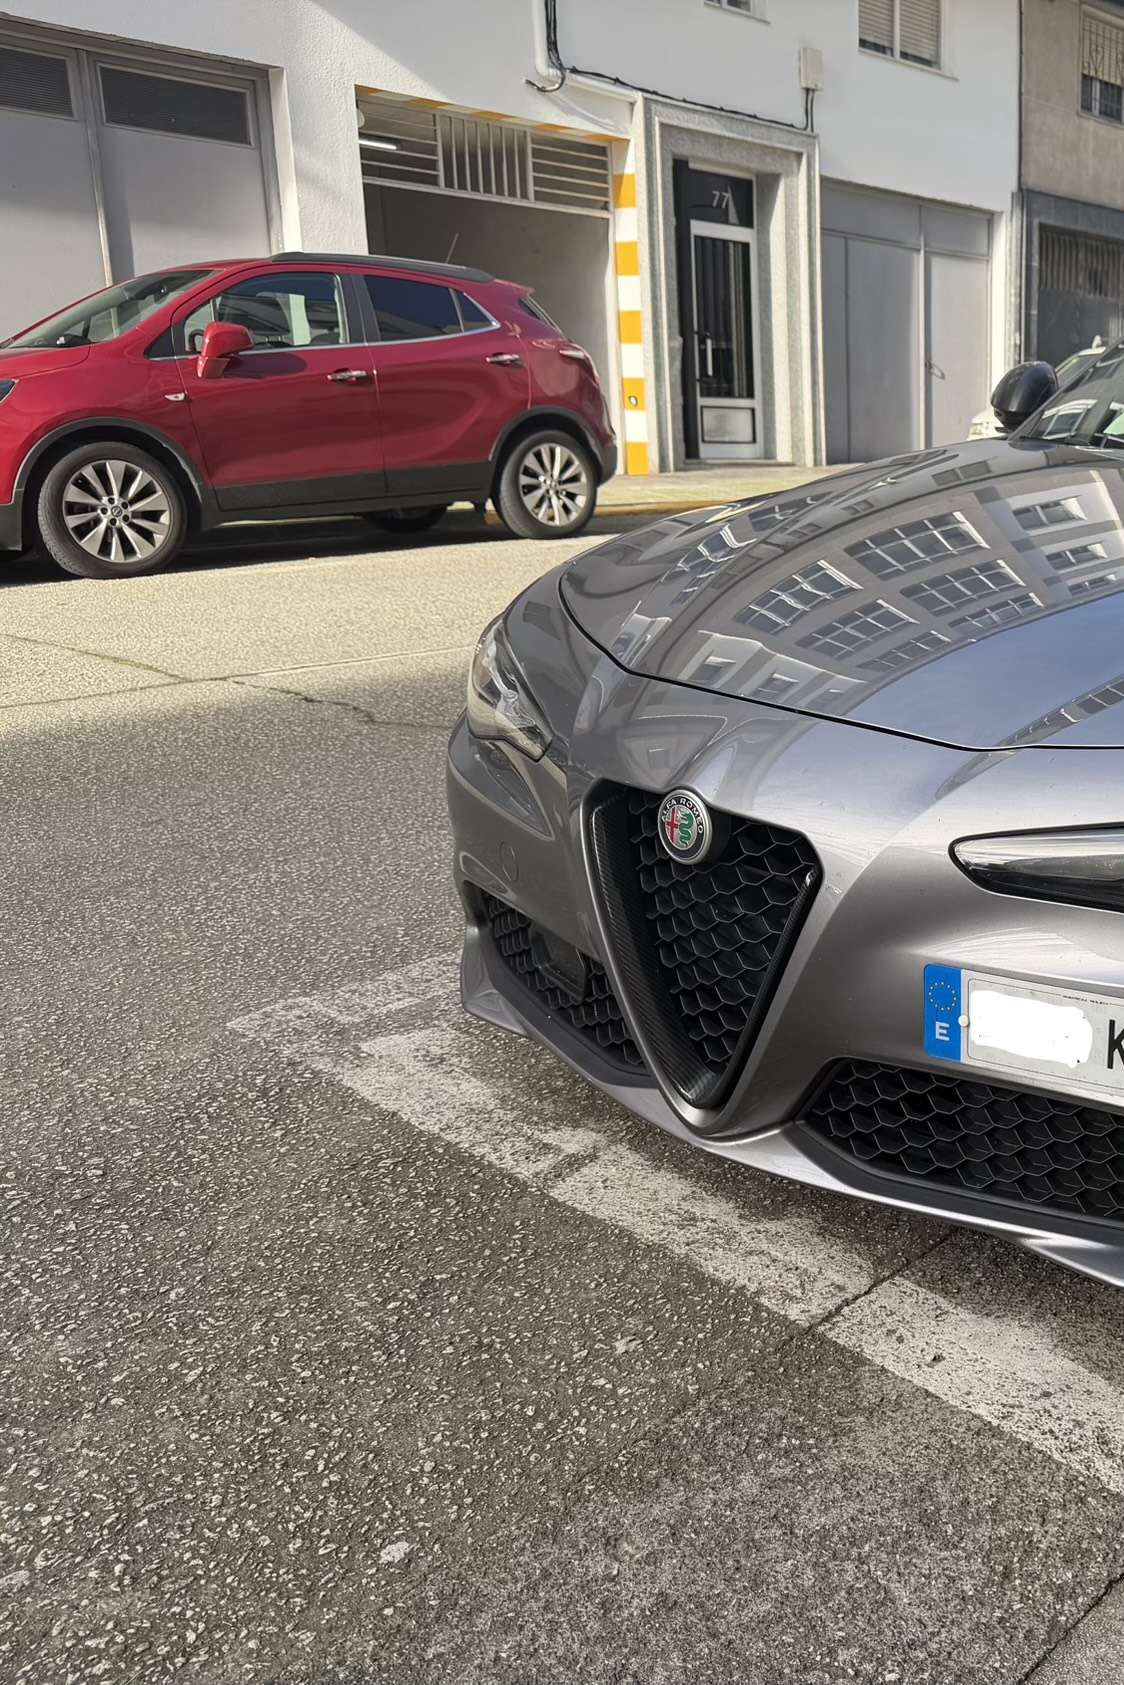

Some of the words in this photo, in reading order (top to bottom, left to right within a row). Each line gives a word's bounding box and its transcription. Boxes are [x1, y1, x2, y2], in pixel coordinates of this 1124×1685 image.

[711, 190, 729, 209] 77
[661, 798, 677, 822] ALFA
[680, 797, 704, 834] ROMEO
[935, 1021, 950, 1041] E
